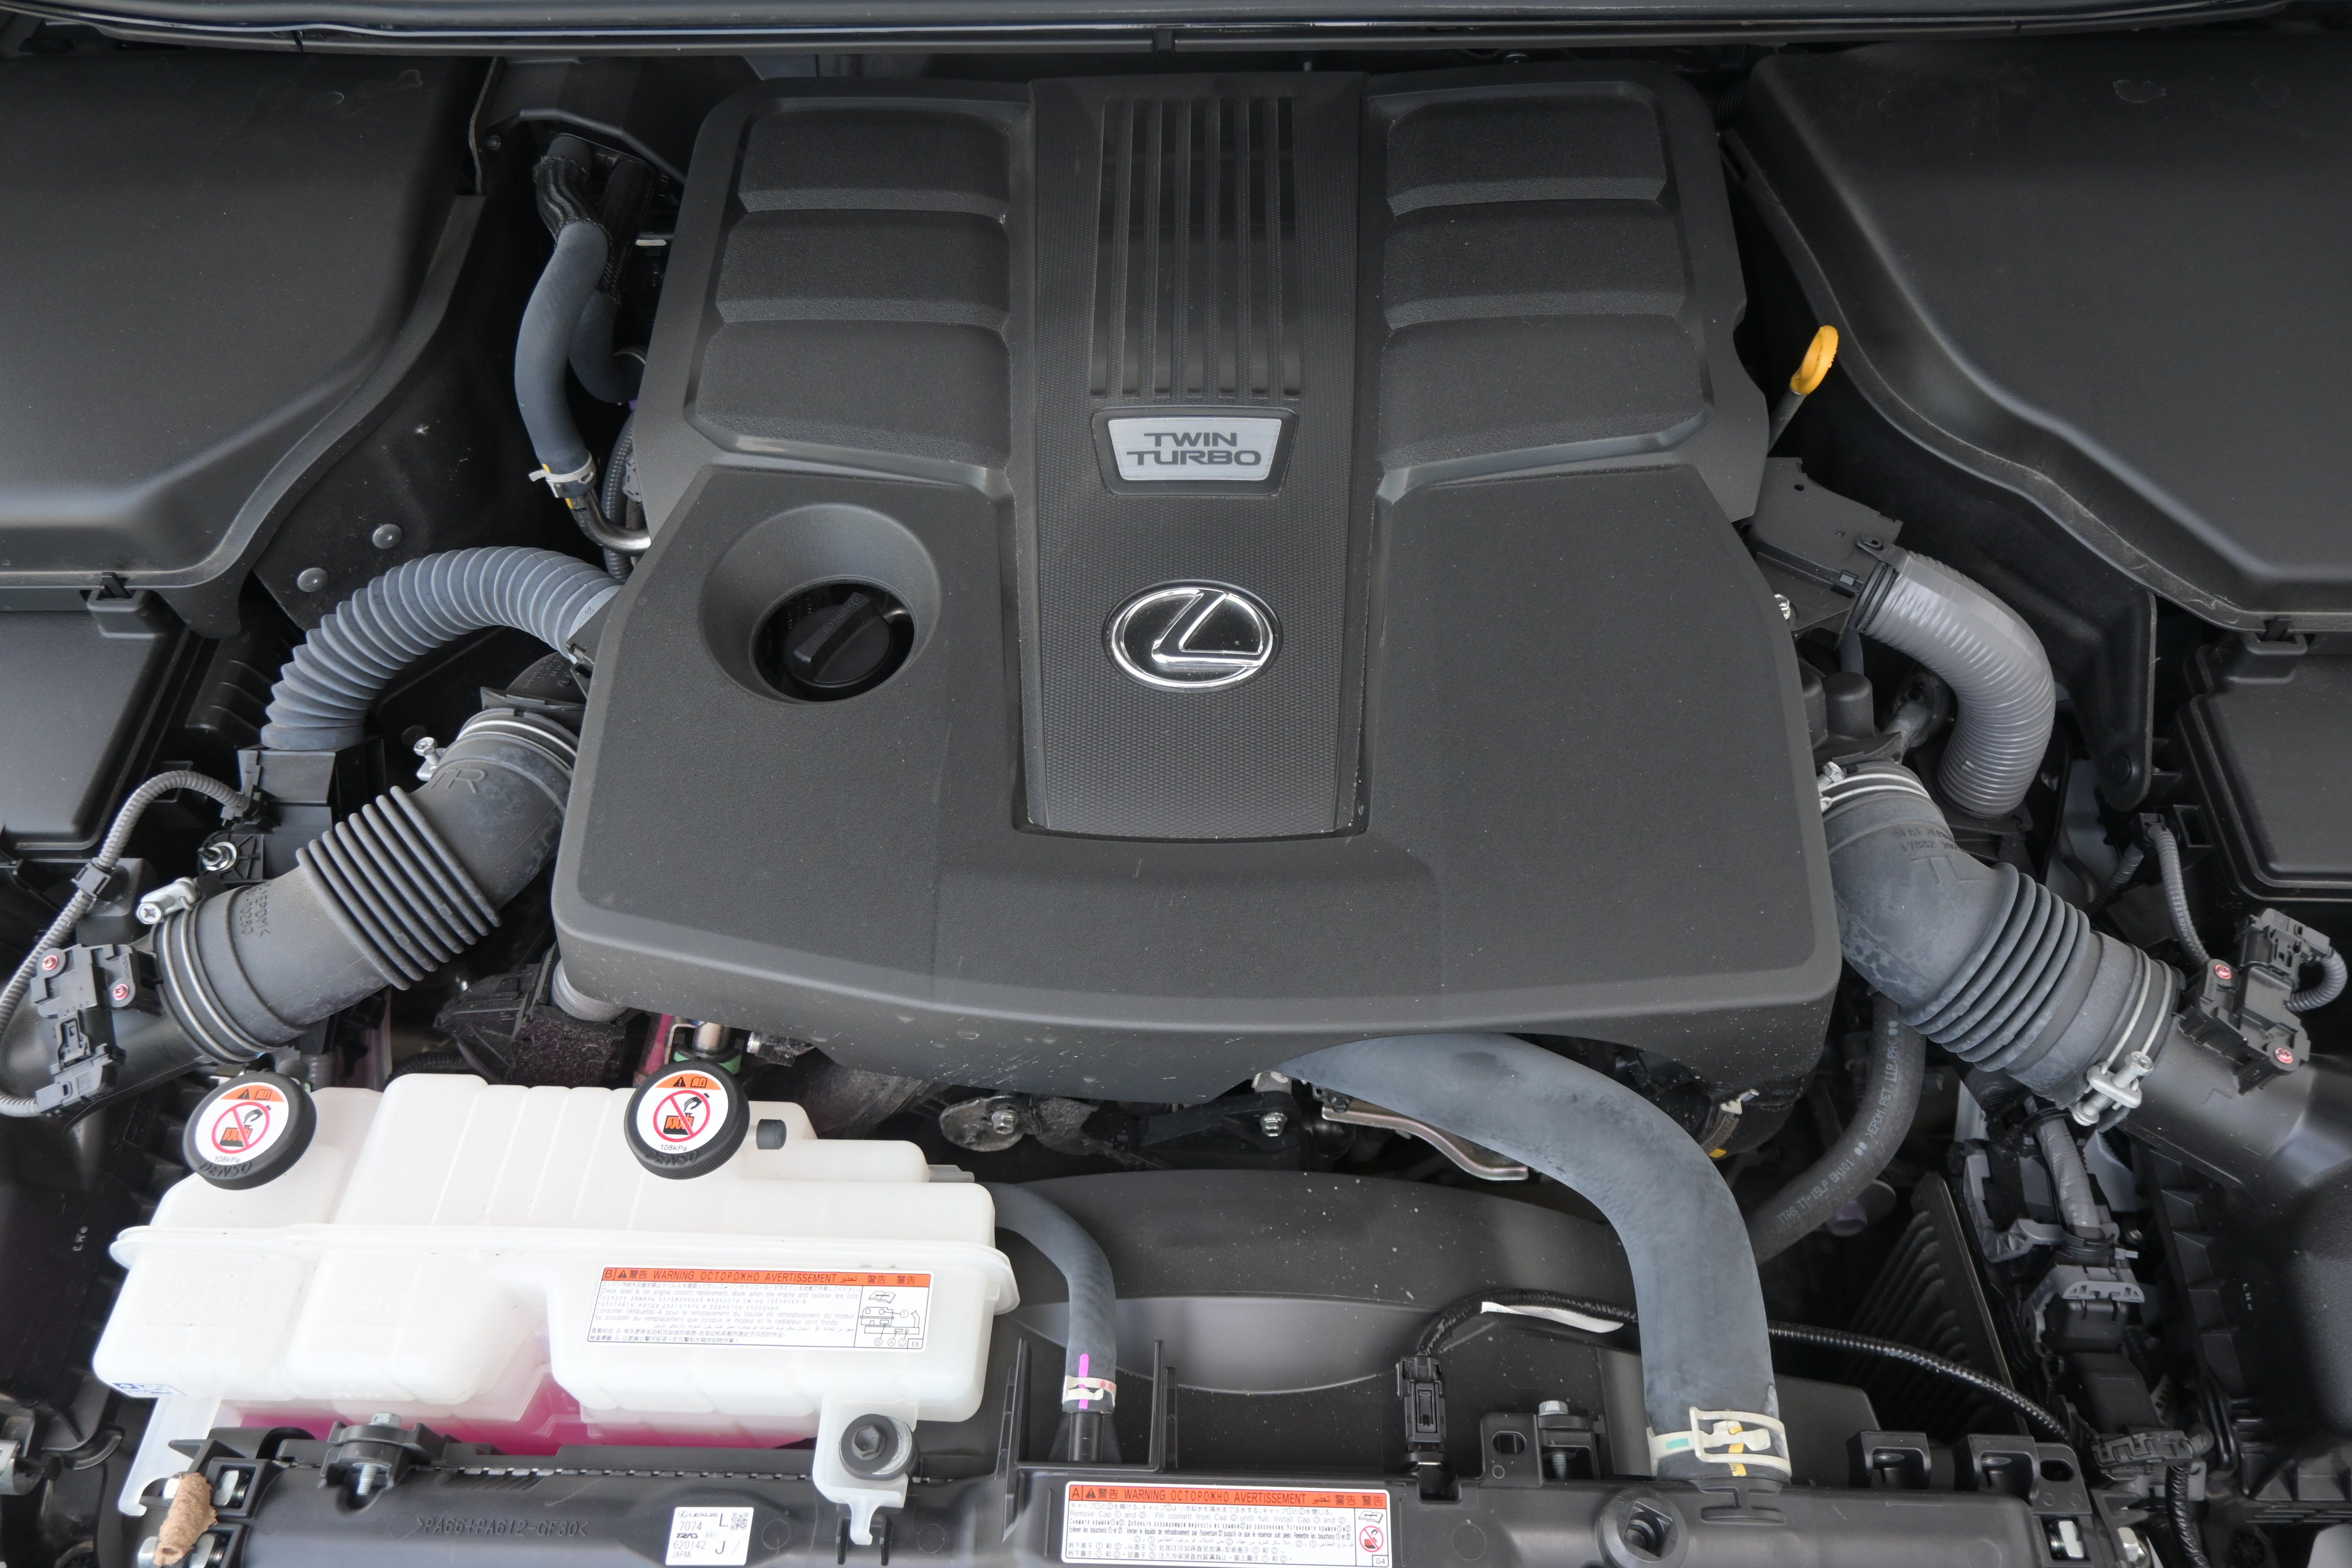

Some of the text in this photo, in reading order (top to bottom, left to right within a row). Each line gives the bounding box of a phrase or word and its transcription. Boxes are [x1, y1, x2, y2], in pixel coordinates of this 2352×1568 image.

[1144, 433, 1237, 447] TWIN
[1127, 450, 1261, 466] TURBO
[644, 1150, 700, 1167] DENSO
[198, 1162, 253, 1178] DENSO
[604, 1269, 613, 1279] B
[629, 1270, 648, 1279] 警告
[653, 1270, 694, 1280] WARNING
[701, 1271, 759, 1281] ОСТОРОЖНО
[765, 1272, 837, 1283] AVERTISSEMENT
[867, 1275, 886, 1284] 警告
[897, 1275, 916, 1285] 警告
[1072, 1487, 1080, 1498] A
[1098, 1488, 1119, 1500] 警告
[1124, 1489, 1165, 1500] WARNING
[1171, 1490, 1229, 1502] ОСТОРОЖНО
[1234, 1492, 1306, 1504] AVERTISSEMENT
[1335, 1494, 1356, 1506] 警告
[1362, 1495, 1383, 1506] 警告
[680, 1521, 702, 1531] 7074
[719, 1513, 729, 1527] L
[673, 1540, 726, 1554] 620142 J
